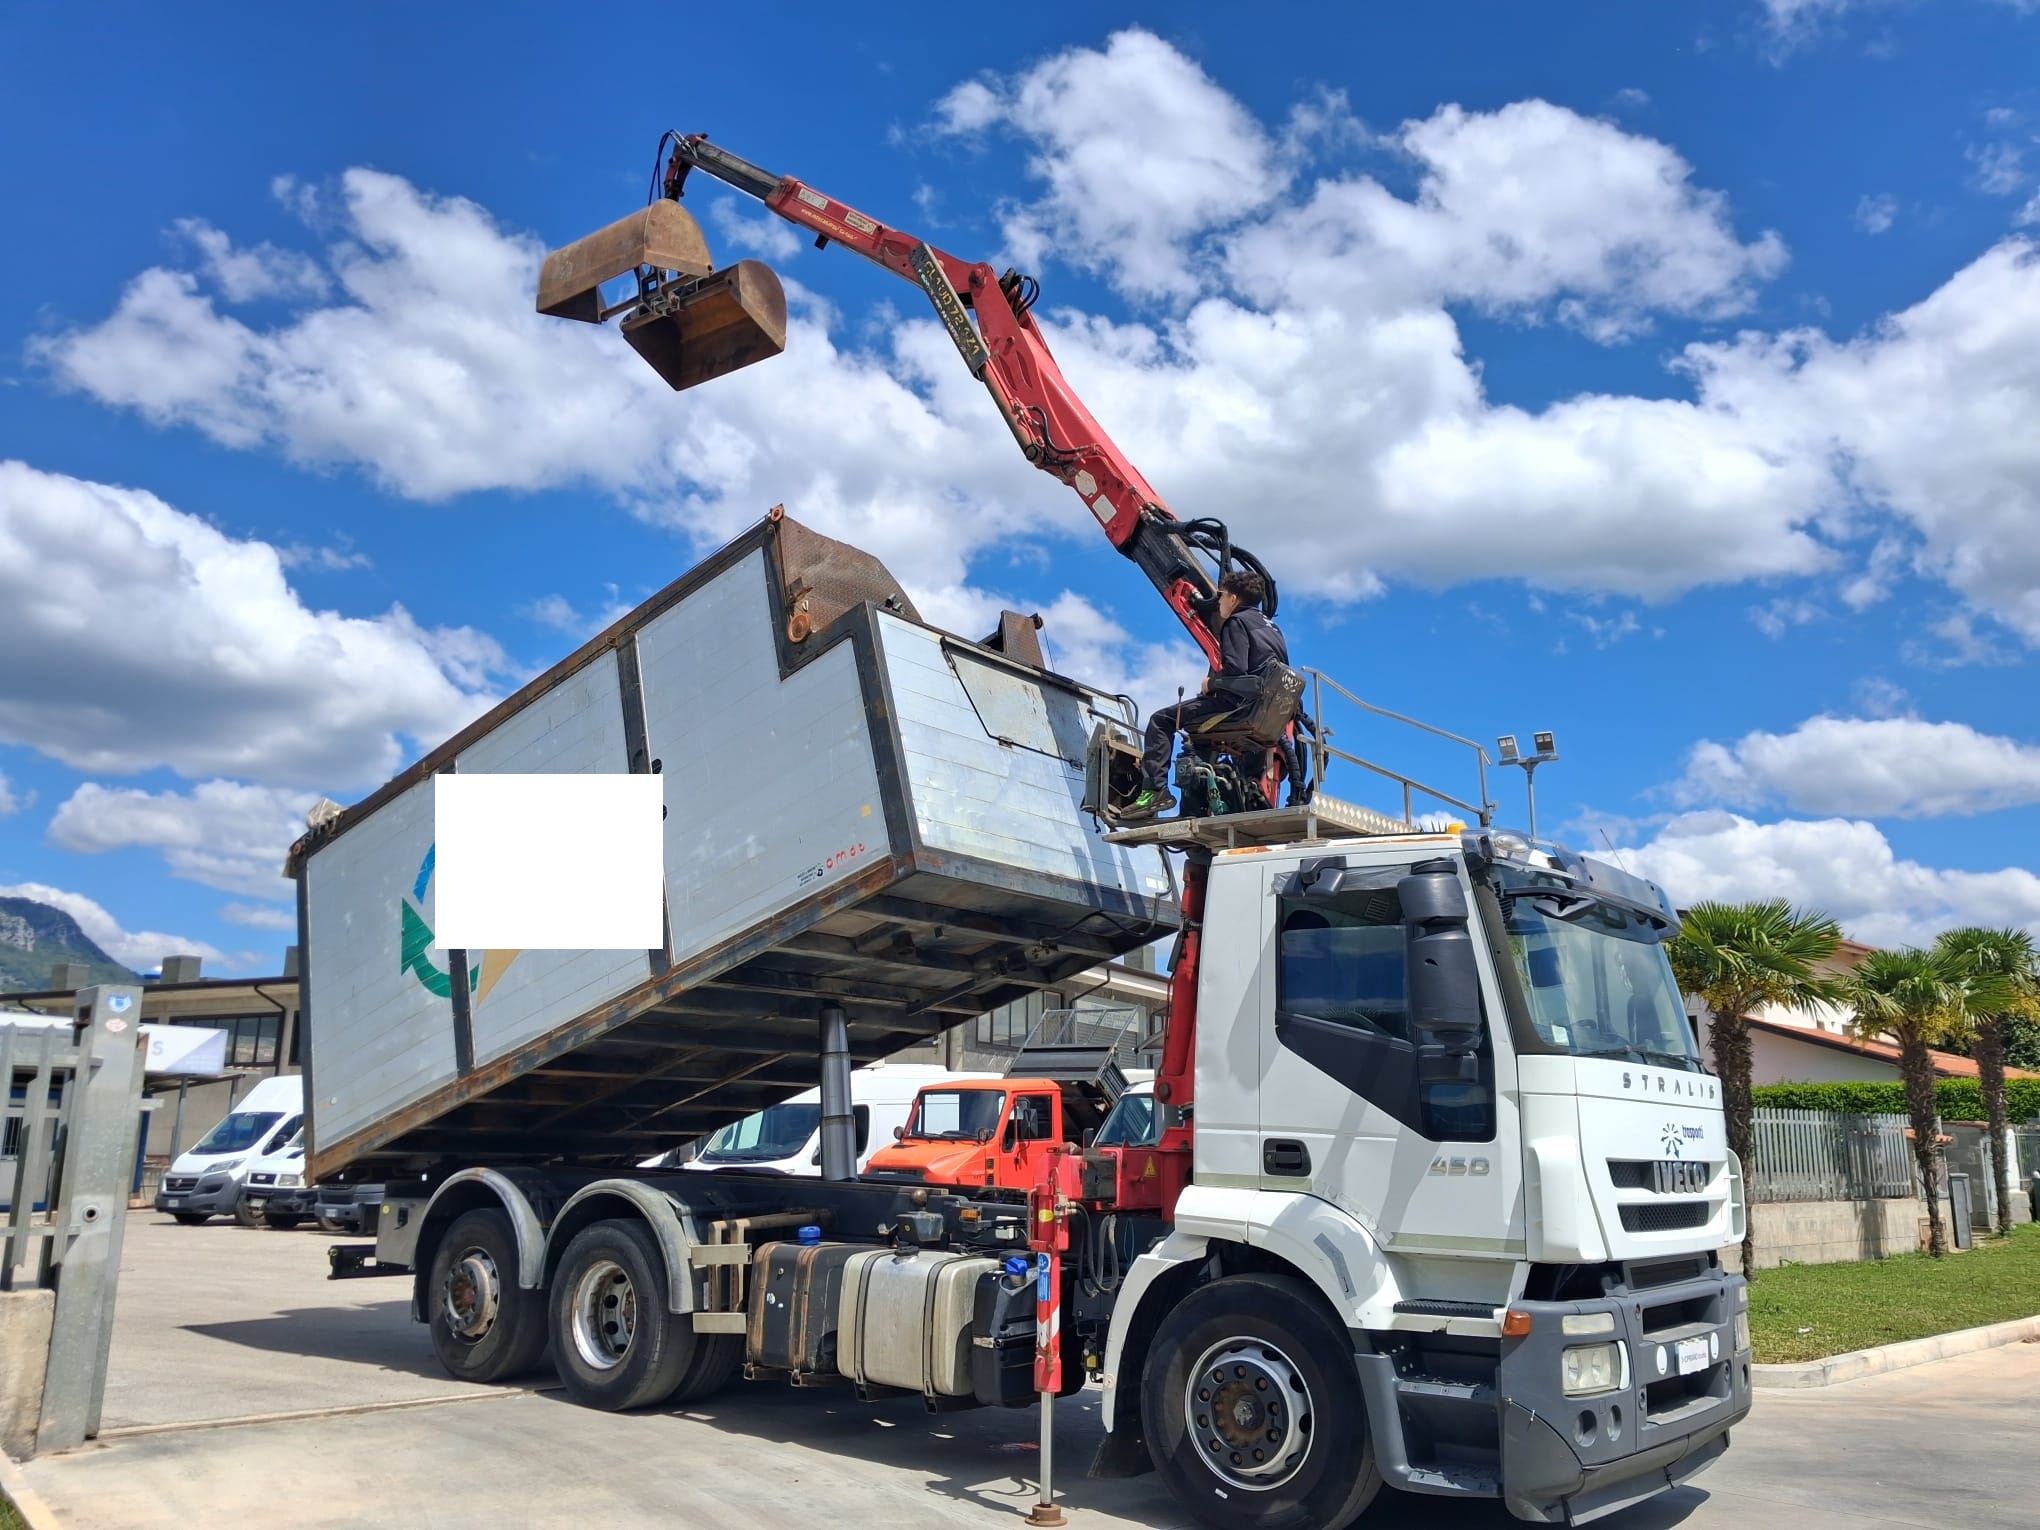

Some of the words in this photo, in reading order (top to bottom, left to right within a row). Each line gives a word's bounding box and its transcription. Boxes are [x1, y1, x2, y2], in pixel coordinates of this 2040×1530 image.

[1622, 1072, 1715, 1099] STRALIS
[1428, 1156, 1491, 1176] 450
[1653, 1160, 1706, 1194] IVECO
